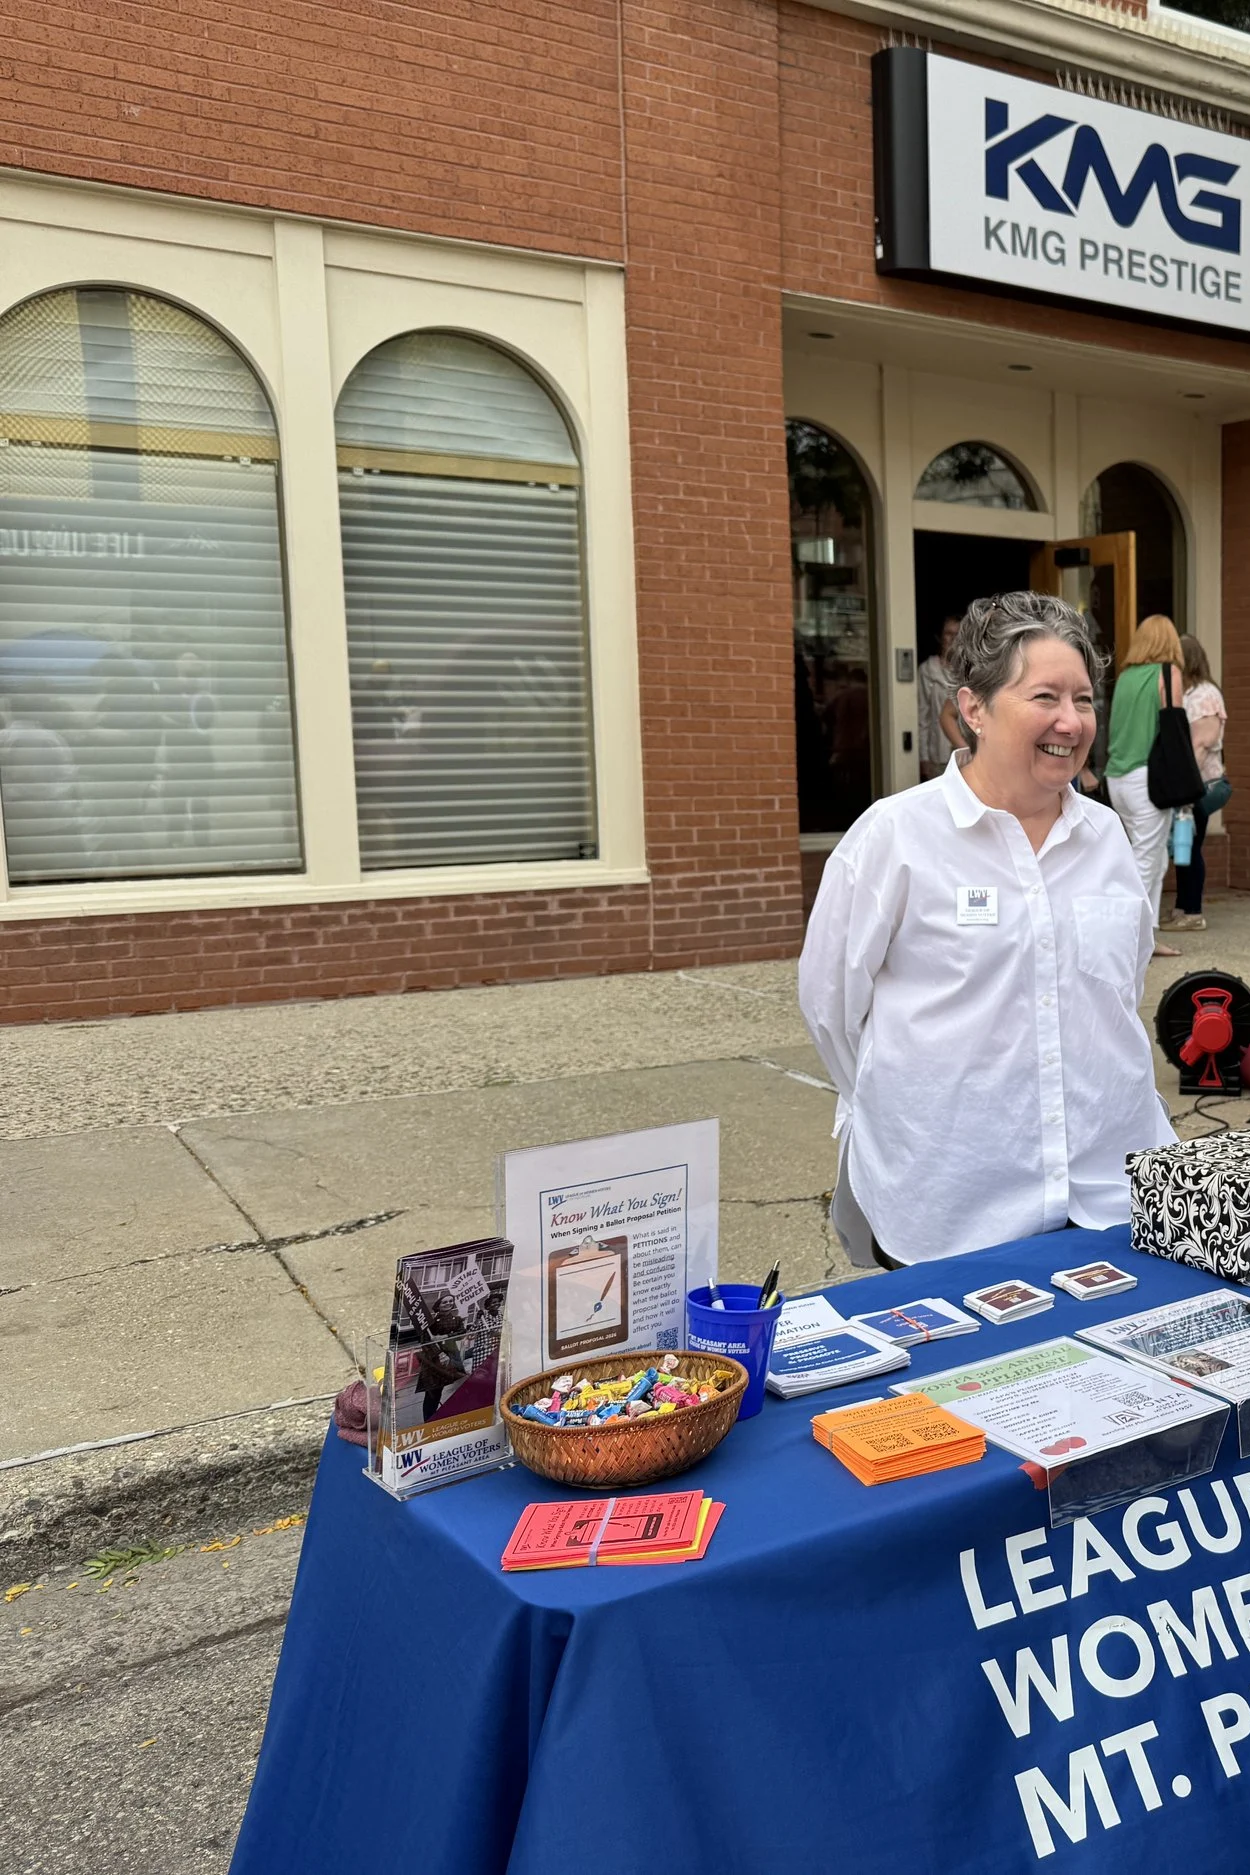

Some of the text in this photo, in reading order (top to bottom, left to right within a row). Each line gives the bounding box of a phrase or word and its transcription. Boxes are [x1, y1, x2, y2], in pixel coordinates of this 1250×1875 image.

[984, 96, 1241, 256] KMG
[983, 215, 1243, 304] KMG PRESTIGE
[548, 1194, 567, 1206] LWV
[550, 1187, 682, 1228] Know What You Sign!
[550, 1230, 571, 1239] When
[572, 1223, 598, 1235] Signing
[605, 1218, 625, 1228] Ballot
[627, 1211, 655, 1223] Proposal
[656, 1206, 681, 1216] Petition
[632, 1232, 649, 1240] What
[657, 1228, 670, 1236] said
[632, 1234, 681, 1249] PETITIONS and
[632, 1251, 649, 1259] about
[671, 1243, 682, 1251] can
[642, 1254, 675, 1267] misleading
[451, 1268, 478, 1289] VOTING
[632, 1270, 645, 1278] and
[632, 1273, 676, 1287] Be certain you
[456, 1280, 483, 1300] PEOPLE
[460, 1286, 485, 1305] POWER
[632, 1282, 671, 1297] know exactly
[632, 1289, 677, 1306] what the ballot
[632, 1303, 659, 1317] proposal
[632, 1316, 644, 1325] and
[645, 1313, 658, 1321] how
[665, 1307, 675, 1316] will
[632, 1324, 650, 1334] affect
[776, 1322, 821, 1336] MATION
[1105, 1321, 1139, 1336] LWV
[560, 1342, 579, 1350] BALLOT
[579, 1335, 605, 1346] PROPOSAL
[697, 1337, 728, 1348] PLEASANT
[707, 1346, 727, 1354] WOMEN
[915, 1375, 974, 1393] ZONTA
[1008, 1345, 1072, 1369] ANNUAL
[1132, 1392, 1187, 1411] ZONTA
[431, 1419, 487, 1438] WOMEN VOTERS
[432, 1420, 459, 1433] LEAGUE
[395, 1428, 425, 1448] LWV
[419, 1442, 501, 1473] WOMEN VOTERS
[433, 1438, 489, 1462] LEAGUE OF
[396, 1449, 423, 1469] LWV
[441, 1460, 472, 1472] PLEASANT
[474, 1454, 490, 1462] AREA
[1014, 1720, 1192, 1859] MT.
